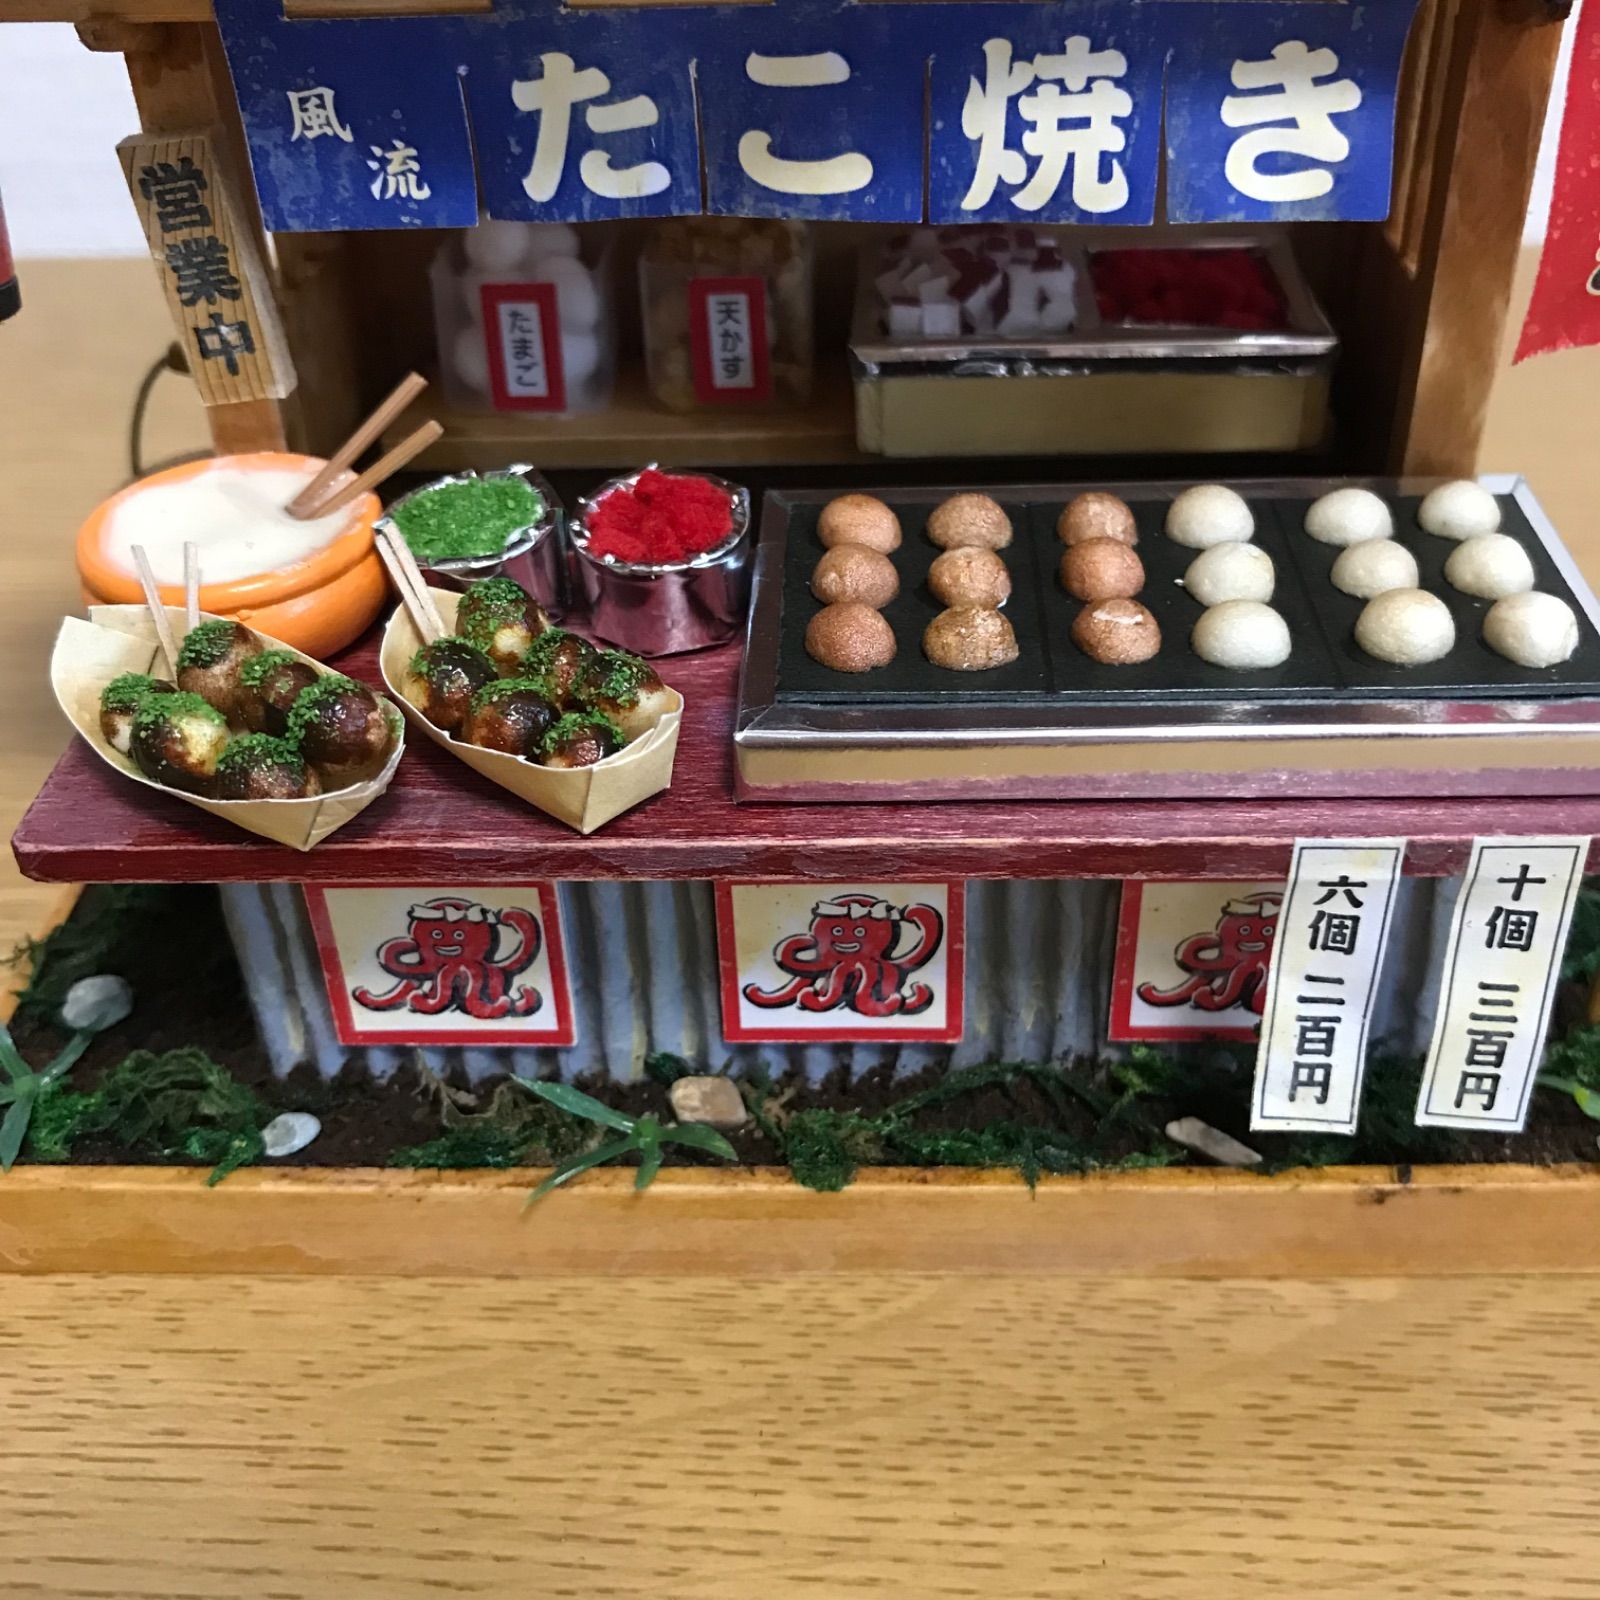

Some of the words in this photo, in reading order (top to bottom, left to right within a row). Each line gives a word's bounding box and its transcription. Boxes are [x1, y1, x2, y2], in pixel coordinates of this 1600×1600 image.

[290, 86, 432, 202] 風流
[511, 35, 1362, 213] たこ焼き
[138, 156, 256, 377] 営業中
[507, 309, 538, 388] たまご
[714, 300, 744, 380] 天かす
